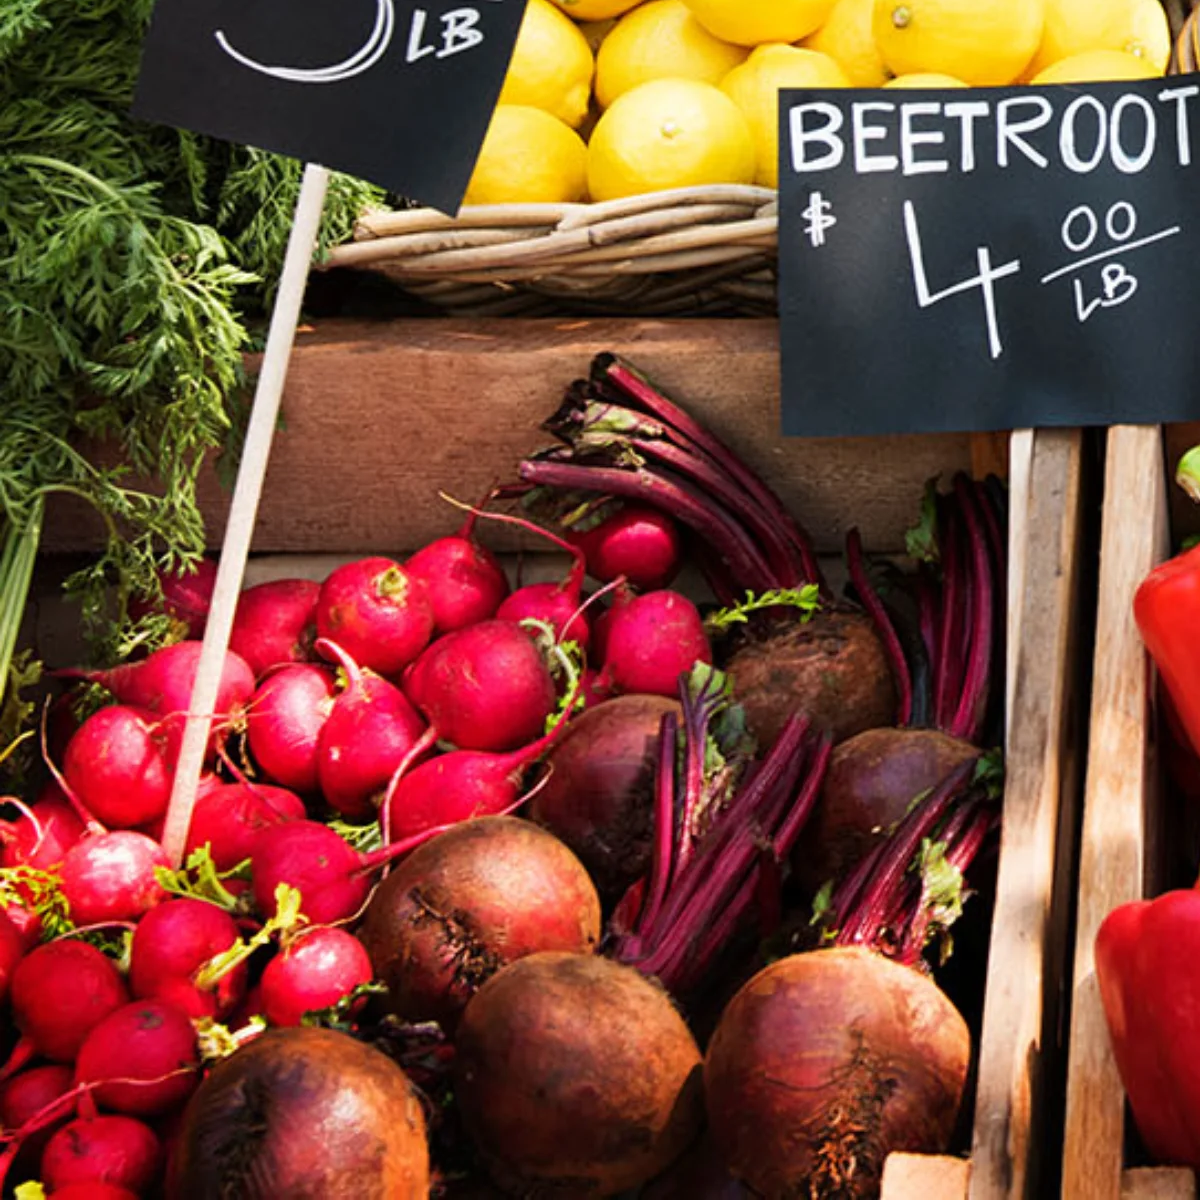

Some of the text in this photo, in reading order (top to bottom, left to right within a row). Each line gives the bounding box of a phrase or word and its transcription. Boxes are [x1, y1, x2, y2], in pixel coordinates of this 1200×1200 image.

[406, 7, 485, 64] LB
[789, 86, 1200, 176] BEETROOT
[1061, 201, 1138, 252] 00
[1073, 263, 1139, 323] LB
